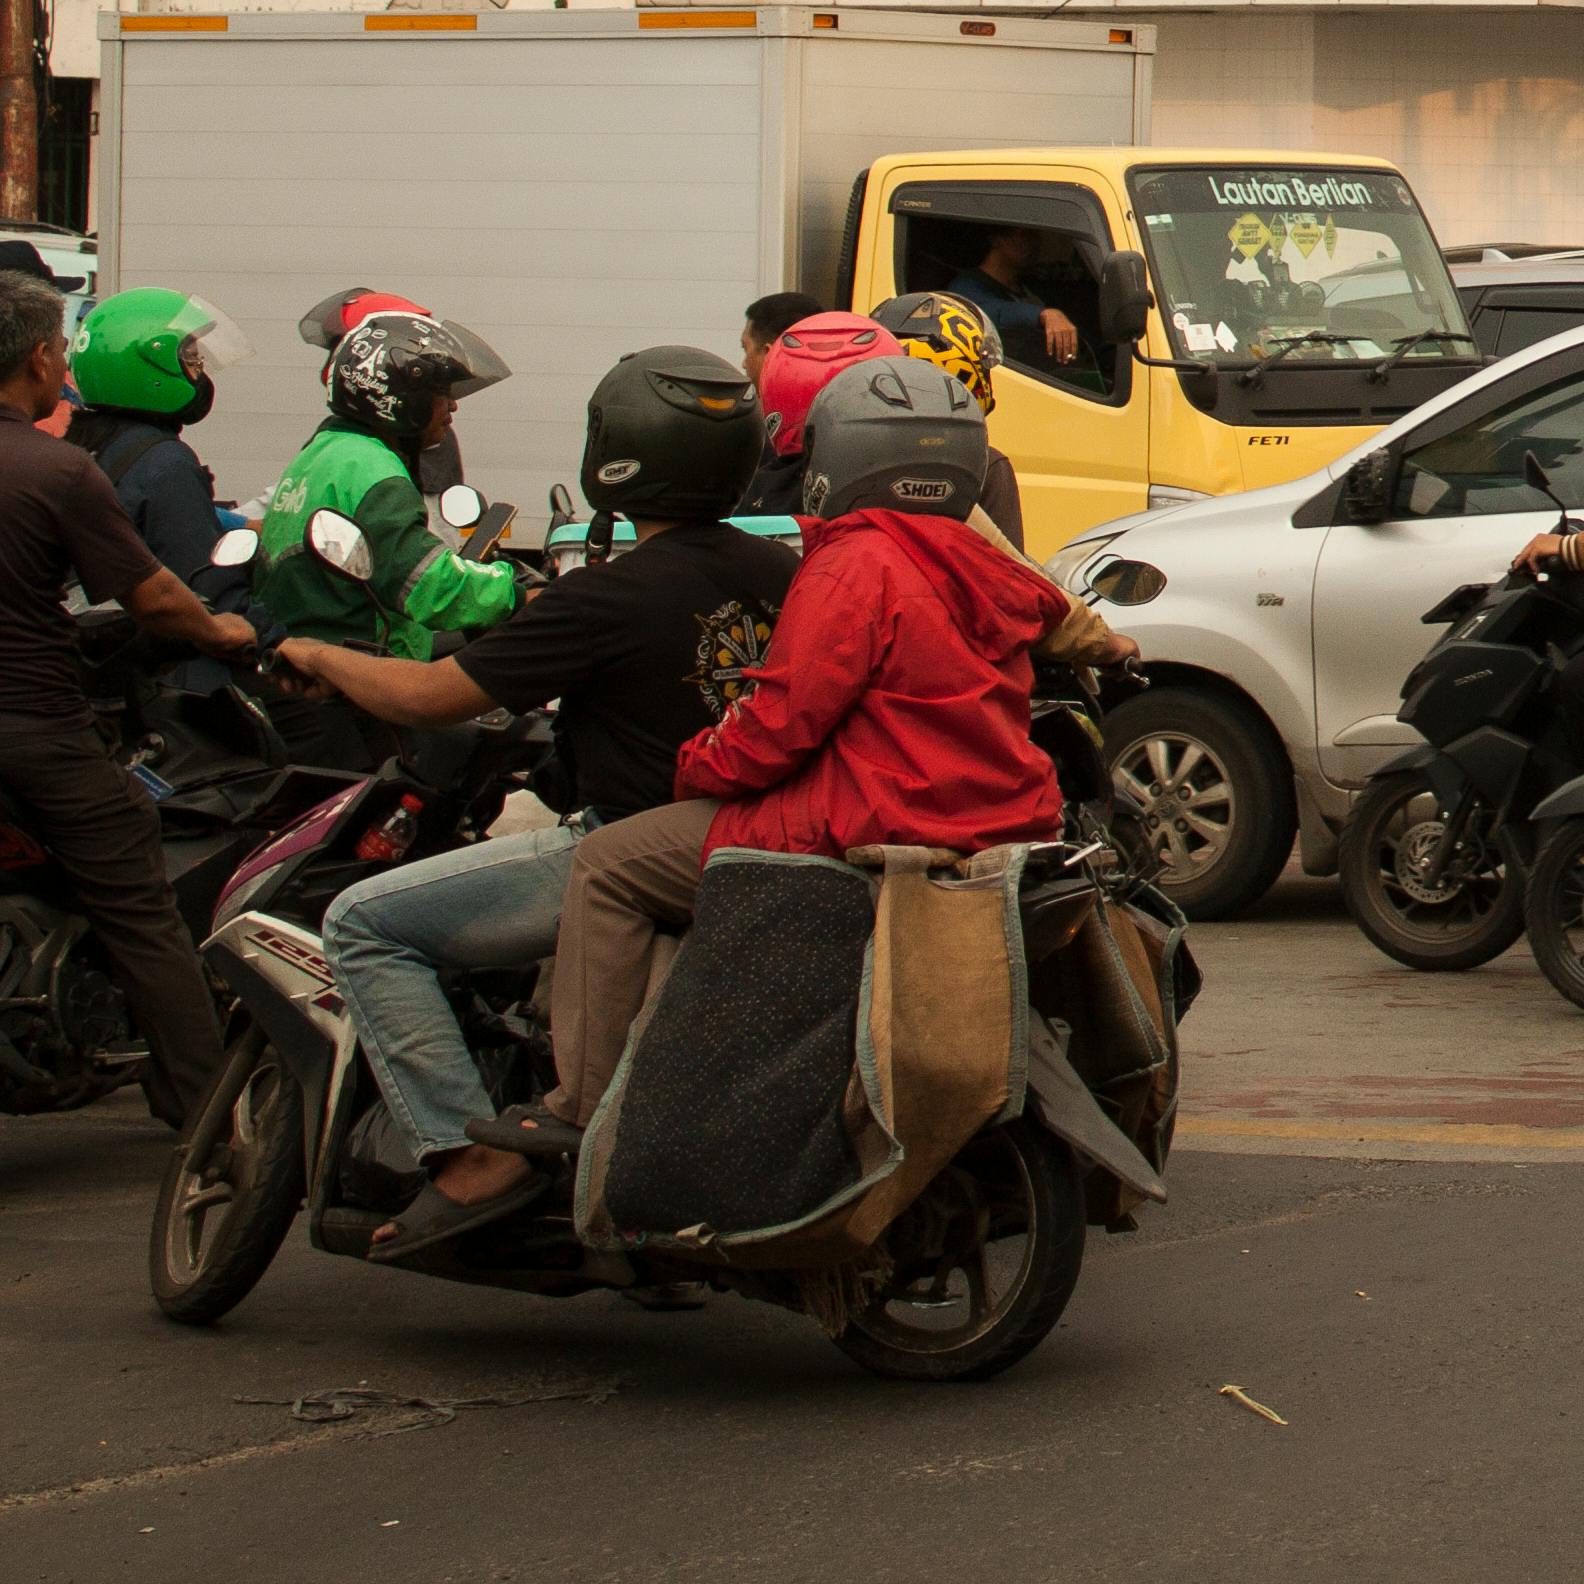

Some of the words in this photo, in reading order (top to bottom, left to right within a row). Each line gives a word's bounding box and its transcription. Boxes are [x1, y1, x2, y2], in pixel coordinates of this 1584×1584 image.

[1209, 176, 1297, 206] Lautan
[1290, 177, 1373, 206] Berlian
[1248, 436, 1290, 446] FE71
[901, 482, 948, 498] SHOEI
